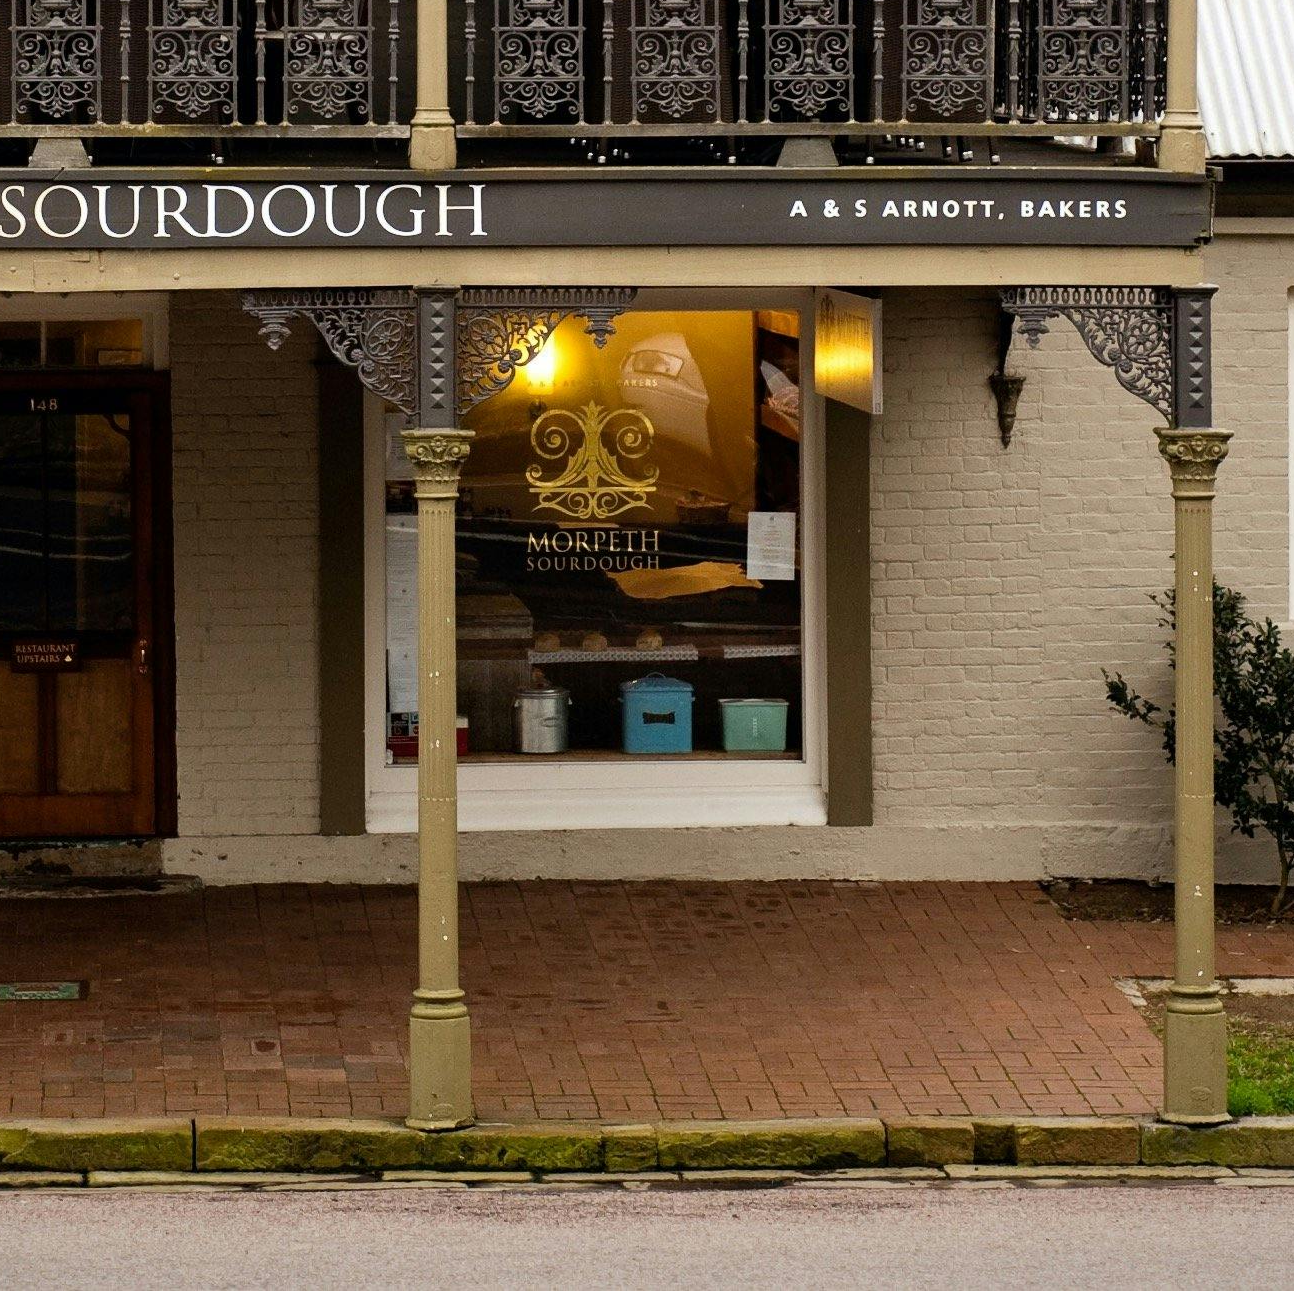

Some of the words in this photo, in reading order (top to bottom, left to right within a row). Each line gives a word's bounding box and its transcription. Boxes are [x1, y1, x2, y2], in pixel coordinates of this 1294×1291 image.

[789, 200, 808, 218] A
[823, 198, 841, 218] &
[854, 198, 867, 218] S
[881, 199, 1005, 220] ARNOTT,
[1020, 199, 1127, 219] BAKERS
[30, 398, 58, 411] 148
[527, 530, 659, 553] MORPETH
[527, 555, 660, 571] SOURDOUGH
[15, 644, 75, 652] RESTAURANT
[17, 654, 60, 663] UPSTAIRS
